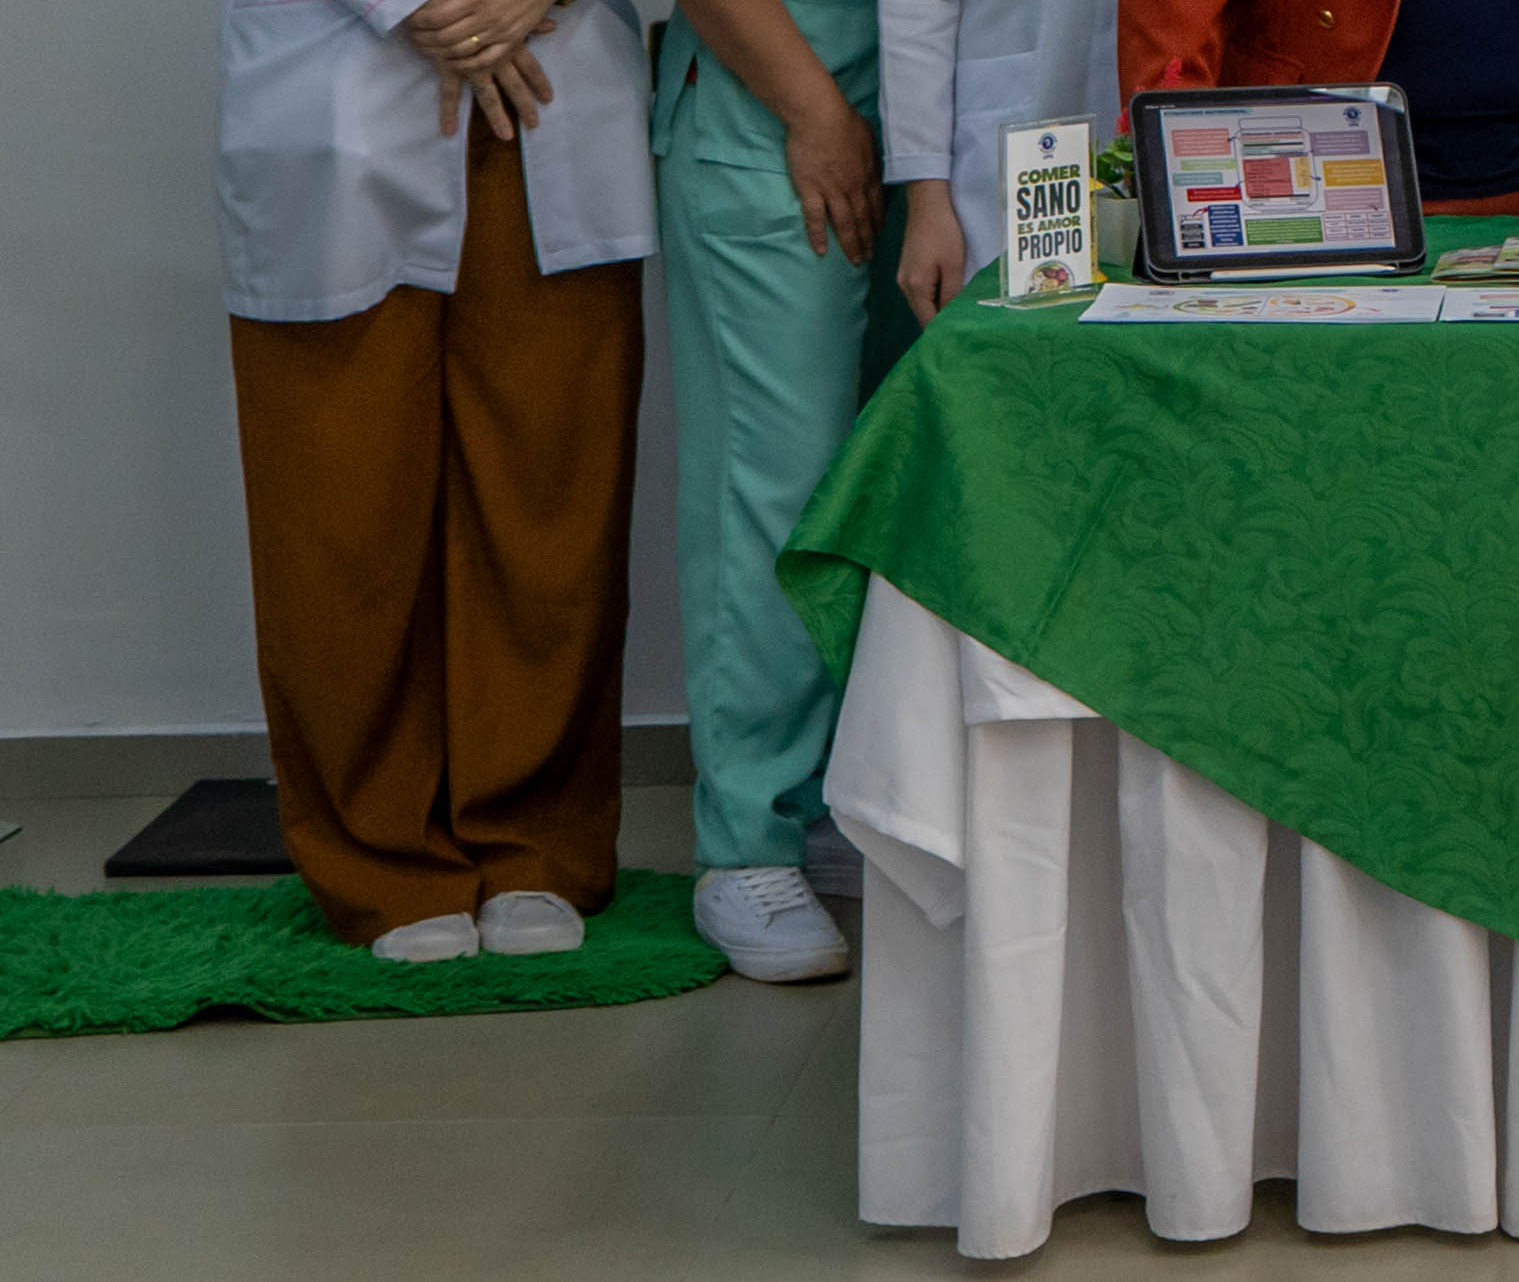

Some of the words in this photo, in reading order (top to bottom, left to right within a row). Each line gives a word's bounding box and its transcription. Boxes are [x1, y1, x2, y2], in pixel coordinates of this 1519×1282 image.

[1017, 164, 1081, 185] COMER
[1016, 179, 1081, 221] SANO
[1018, 221, 1034, 235] ES
[1037, 216, 1081, 233] AMOR
[1018, 228, 1083, 261] PROPIO
